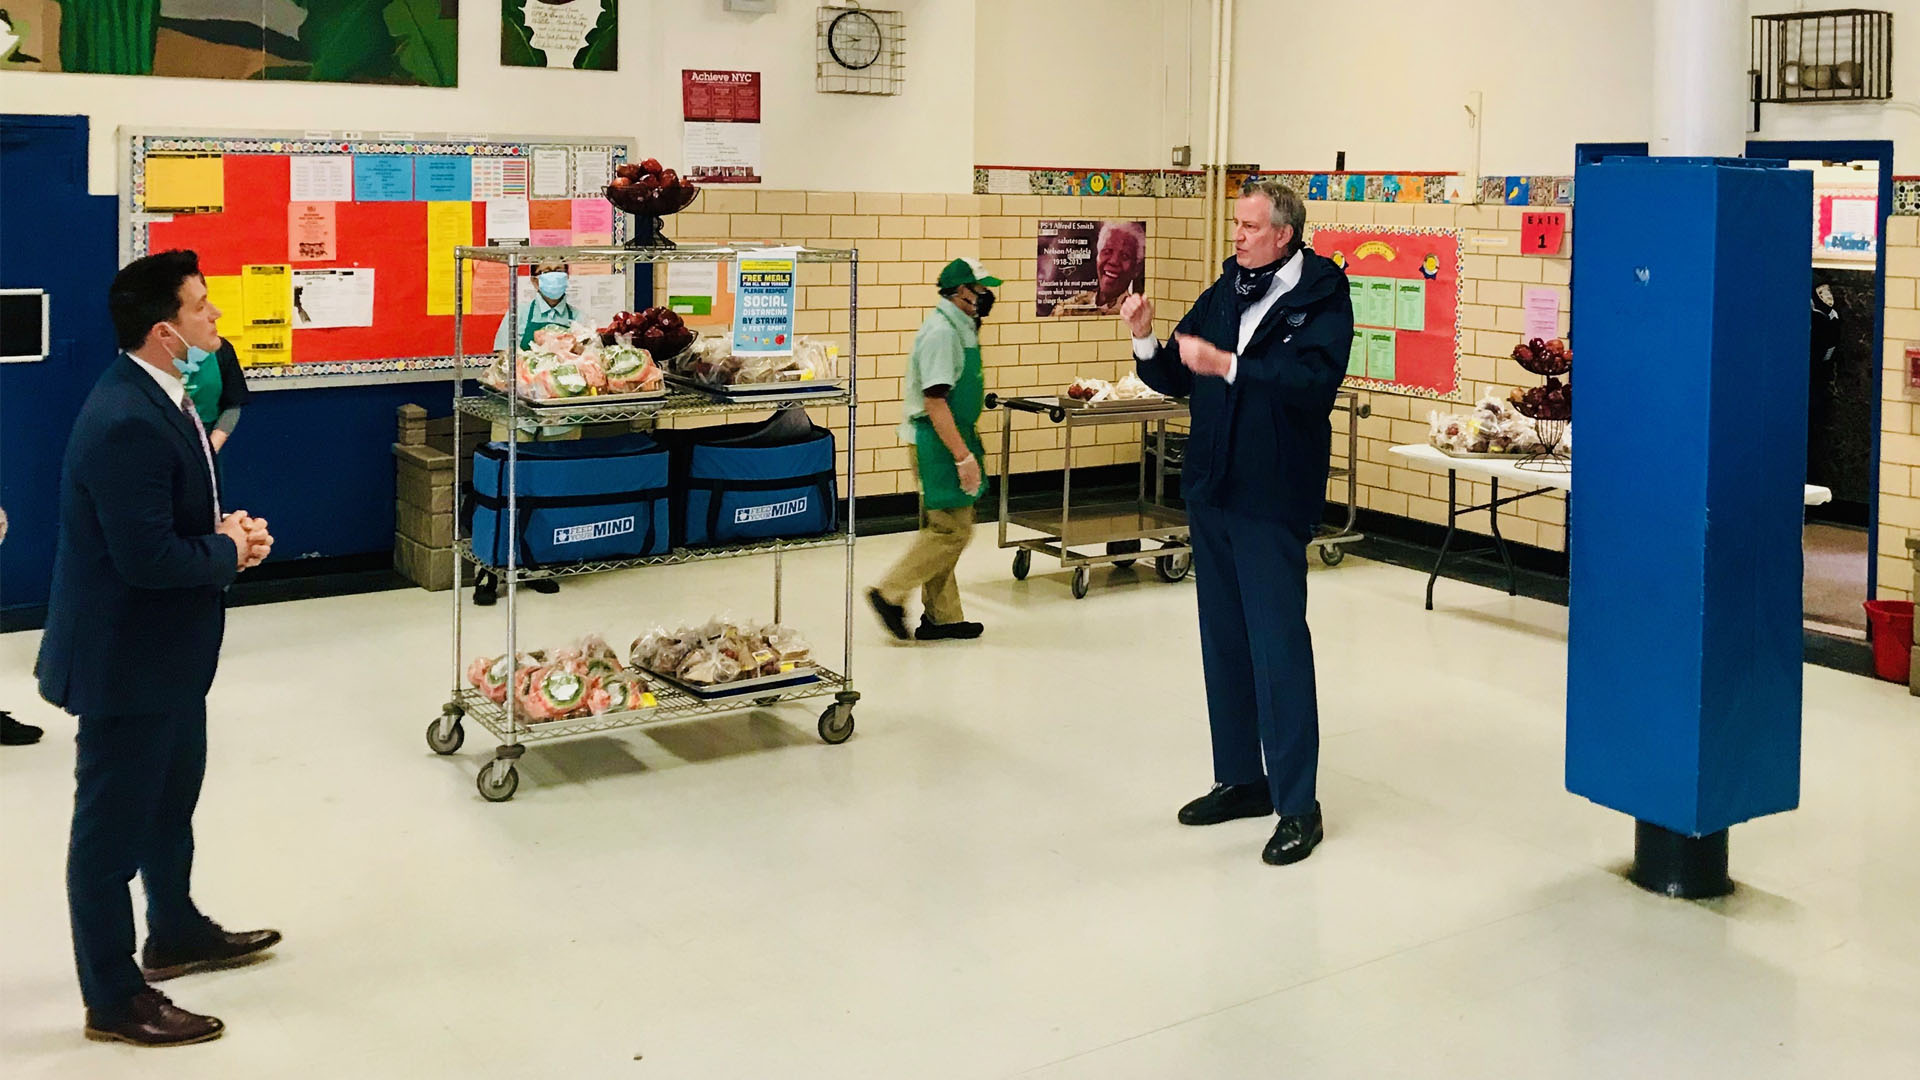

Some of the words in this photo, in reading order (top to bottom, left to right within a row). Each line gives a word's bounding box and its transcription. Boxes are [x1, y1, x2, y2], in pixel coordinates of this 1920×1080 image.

[691, 72, 730, 82] Achieve
[732, 73, 752, 82] NYC
[1072, 222, 1076, 230] E
[1077, 222, 1094, 230] Smith
[1538, 234, 1546, 248] 1
[742, 274, 762, 282] FREE
[764, 274, 790, 282] MEALS
[743, 296, 787, 307] SOCIAL
[772, 500, 805, 516] MIND
[594, 519, 632, 537] MIND
